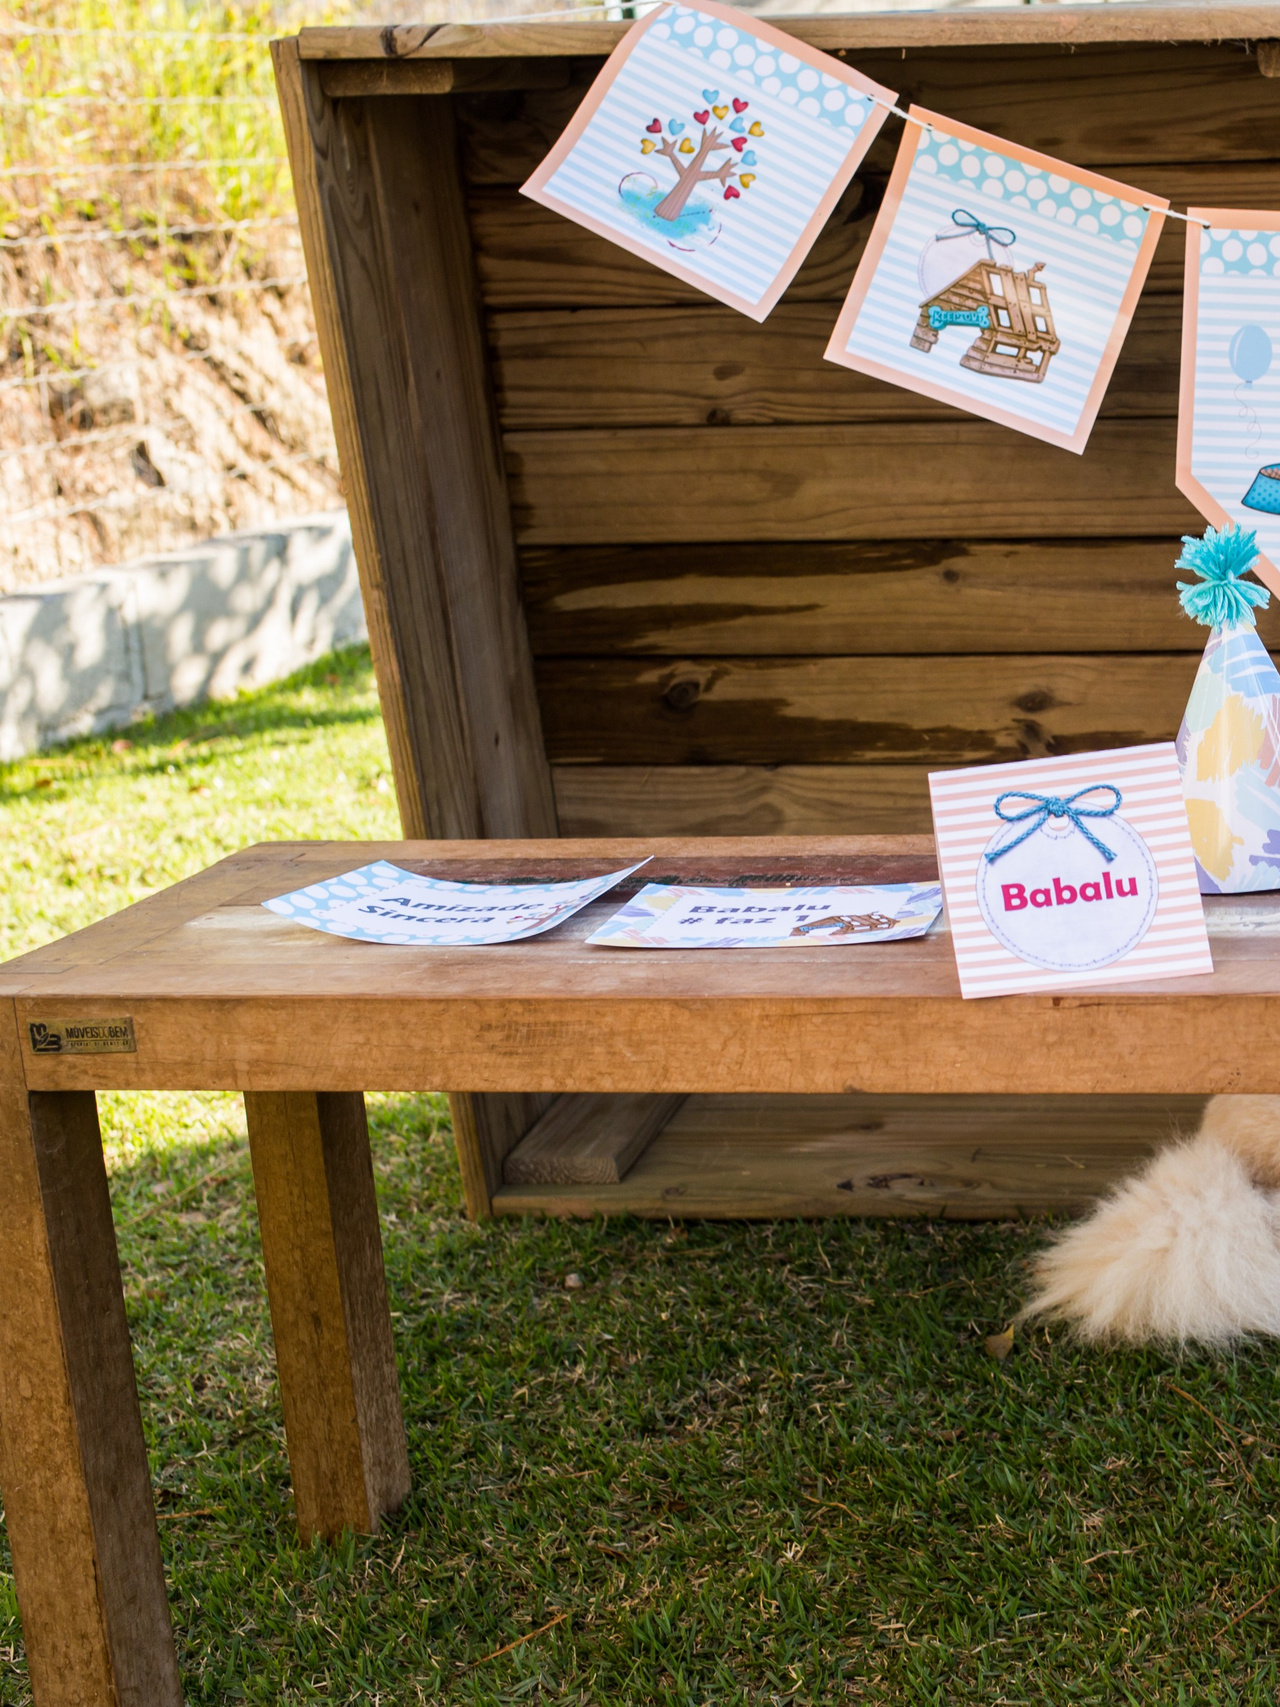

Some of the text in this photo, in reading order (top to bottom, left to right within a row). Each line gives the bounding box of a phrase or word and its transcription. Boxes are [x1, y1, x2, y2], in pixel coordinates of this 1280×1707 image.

[1001, 871, 1139, 911] Babalu
[379, 897, 545, 912] Amizade
[689, 904, 832, 914] Babalu
[358, 905, 496, 924] Sincera
[715, 917, 777, 925] faz
